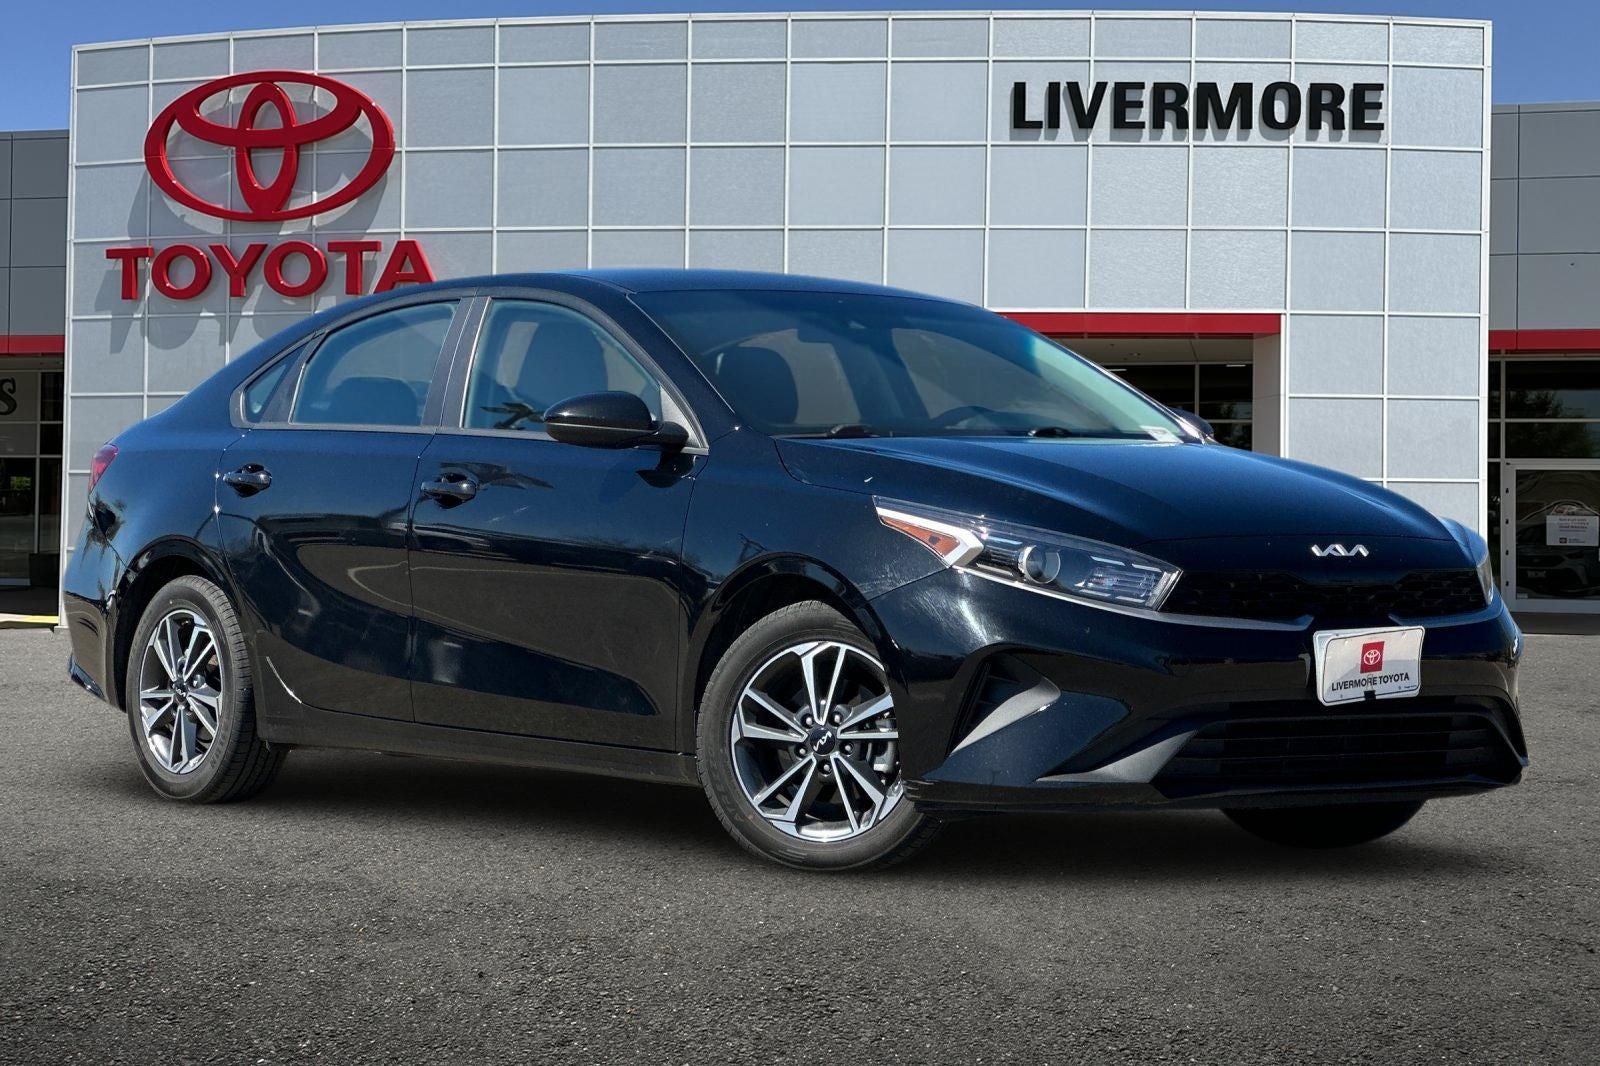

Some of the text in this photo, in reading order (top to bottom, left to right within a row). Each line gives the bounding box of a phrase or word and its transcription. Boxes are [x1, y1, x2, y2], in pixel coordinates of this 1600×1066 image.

[1012, 81, 1385, 132] LIVERMORE
[106, 240, 436, 300] TOYOTA
[1331, 672, 1410, 691] LIVERMORE TOYOTA
